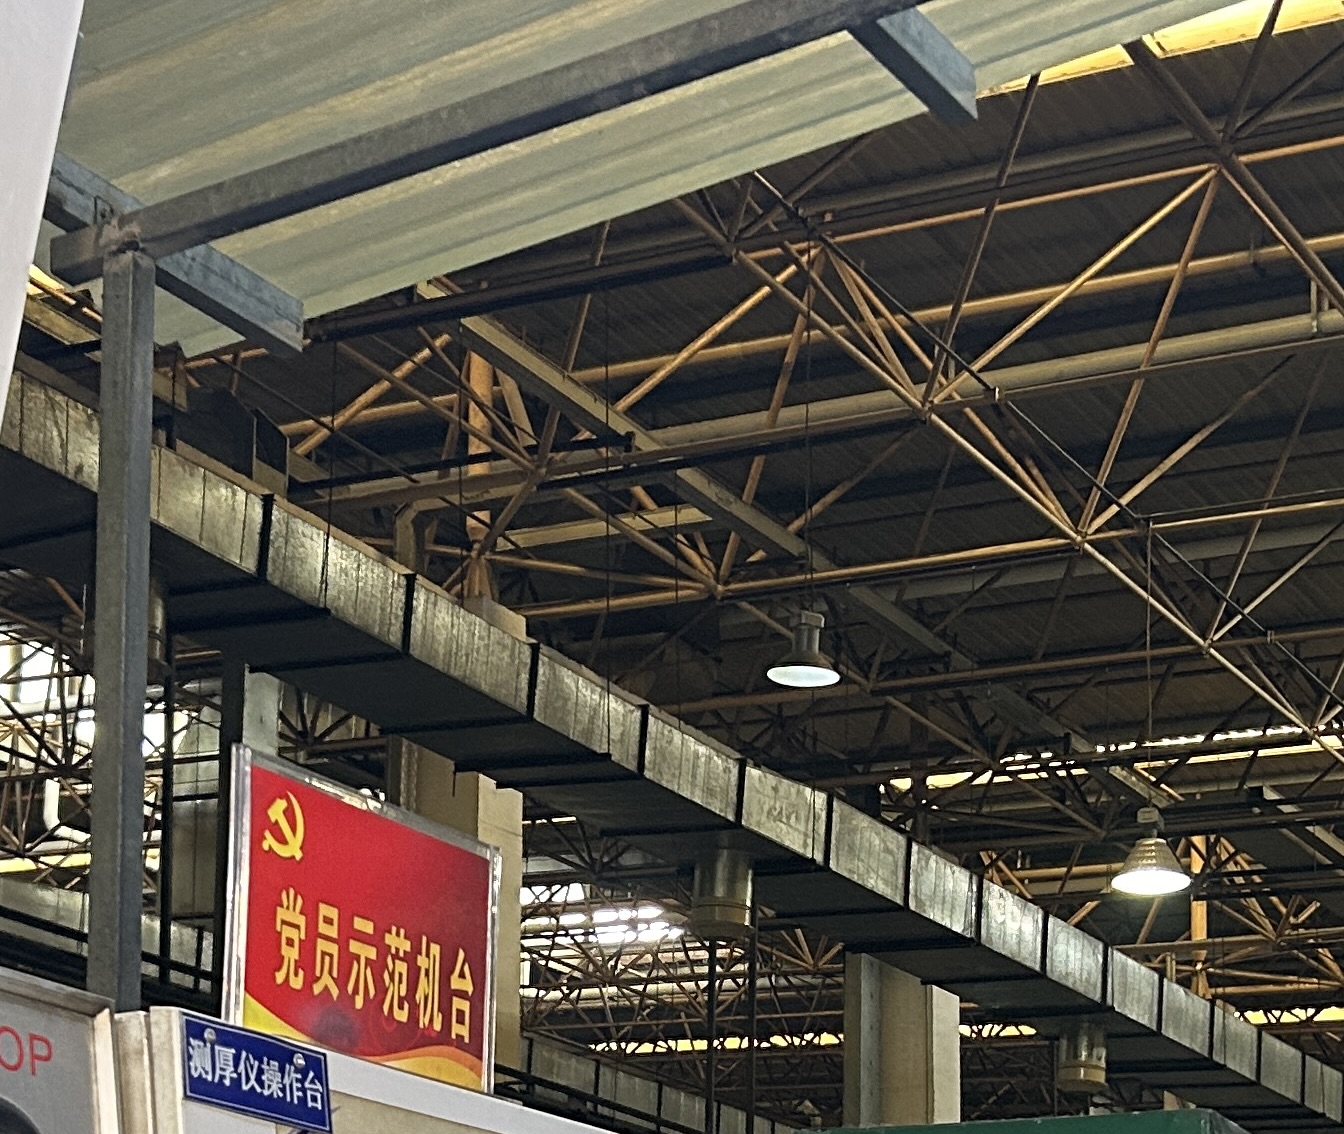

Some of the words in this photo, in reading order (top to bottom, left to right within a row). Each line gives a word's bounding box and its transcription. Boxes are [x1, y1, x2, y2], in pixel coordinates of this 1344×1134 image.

[275, 887, 474, 1043] 党员示范机台
[188, 1036, 324, 1111] 测厚仪操作台
